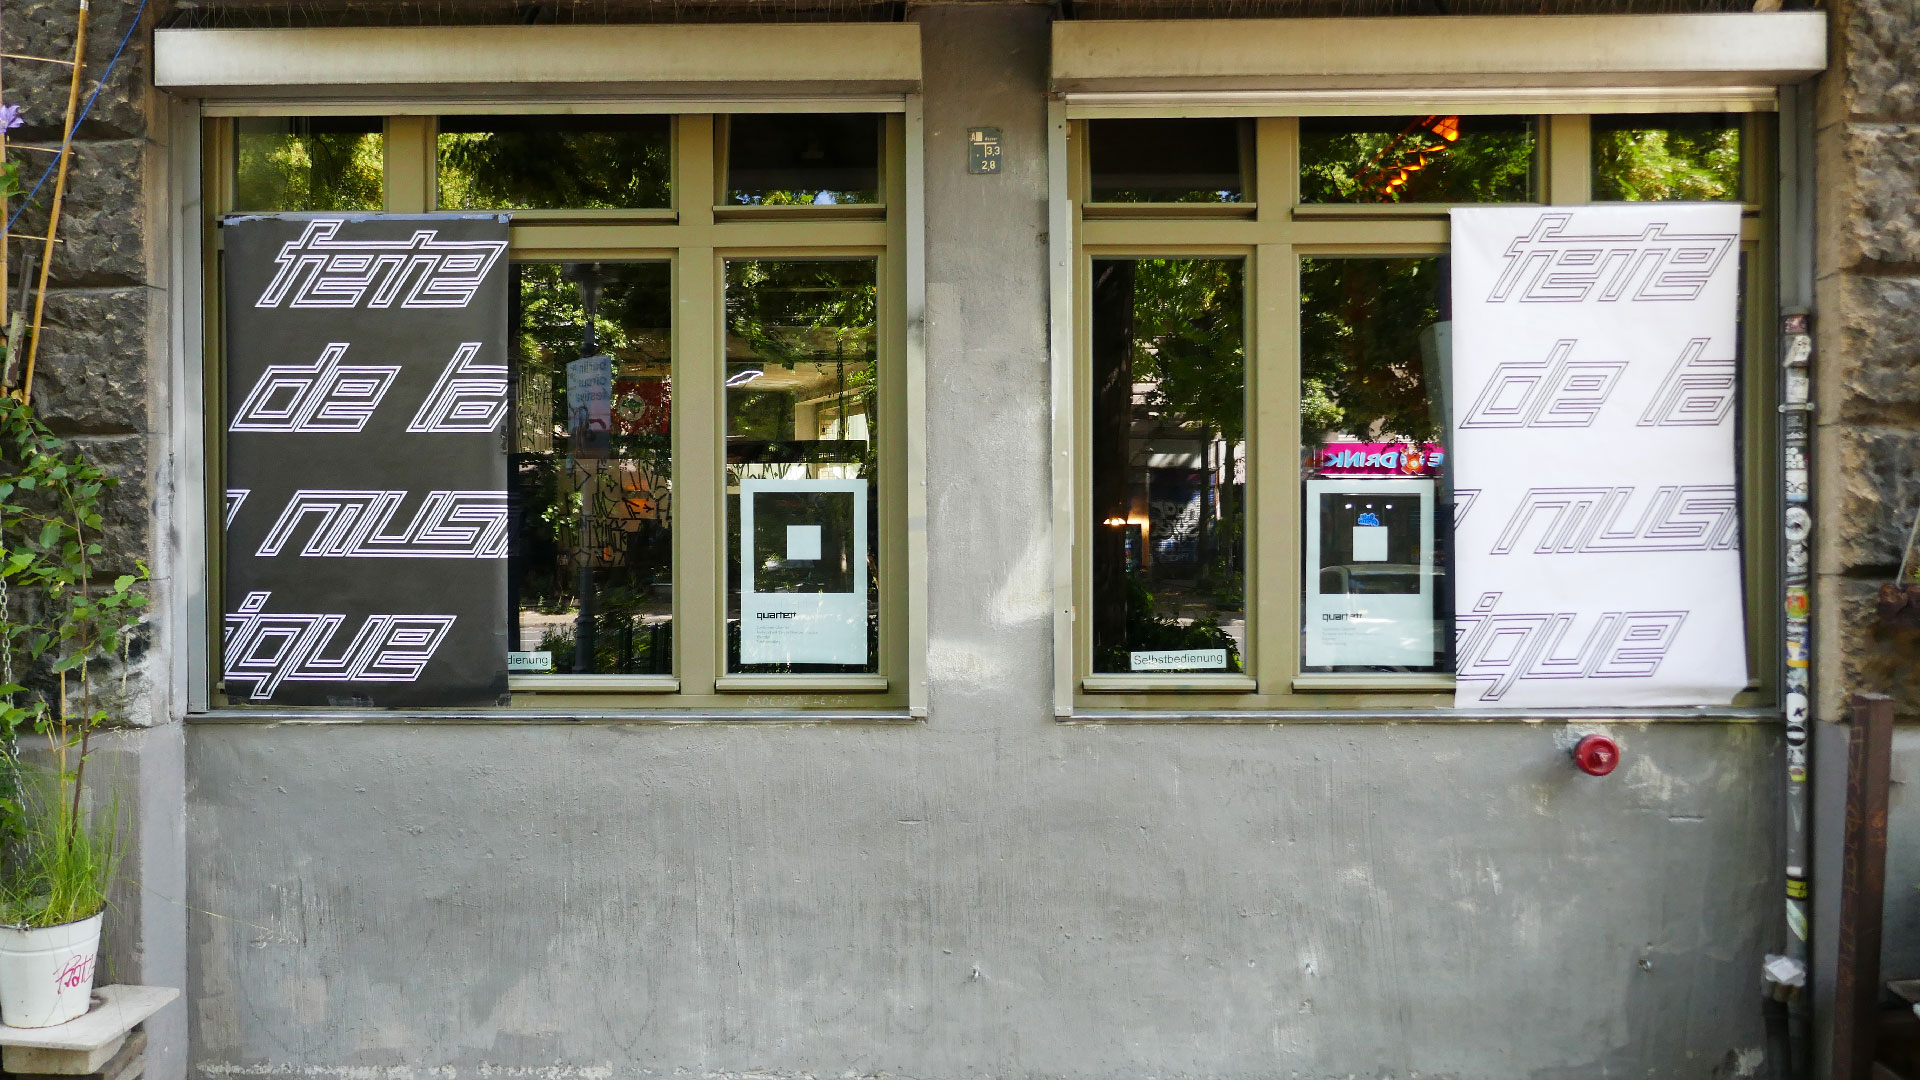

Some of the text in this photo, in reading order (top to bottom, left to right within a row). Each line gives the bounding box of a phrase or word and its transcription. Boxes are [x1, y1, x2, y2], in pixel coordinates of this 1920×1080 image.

[228, 342, 402, 432] de
[1458, 338, 1629, 429] de
[1133, 653, 1223, 665] Selbstbedienung
